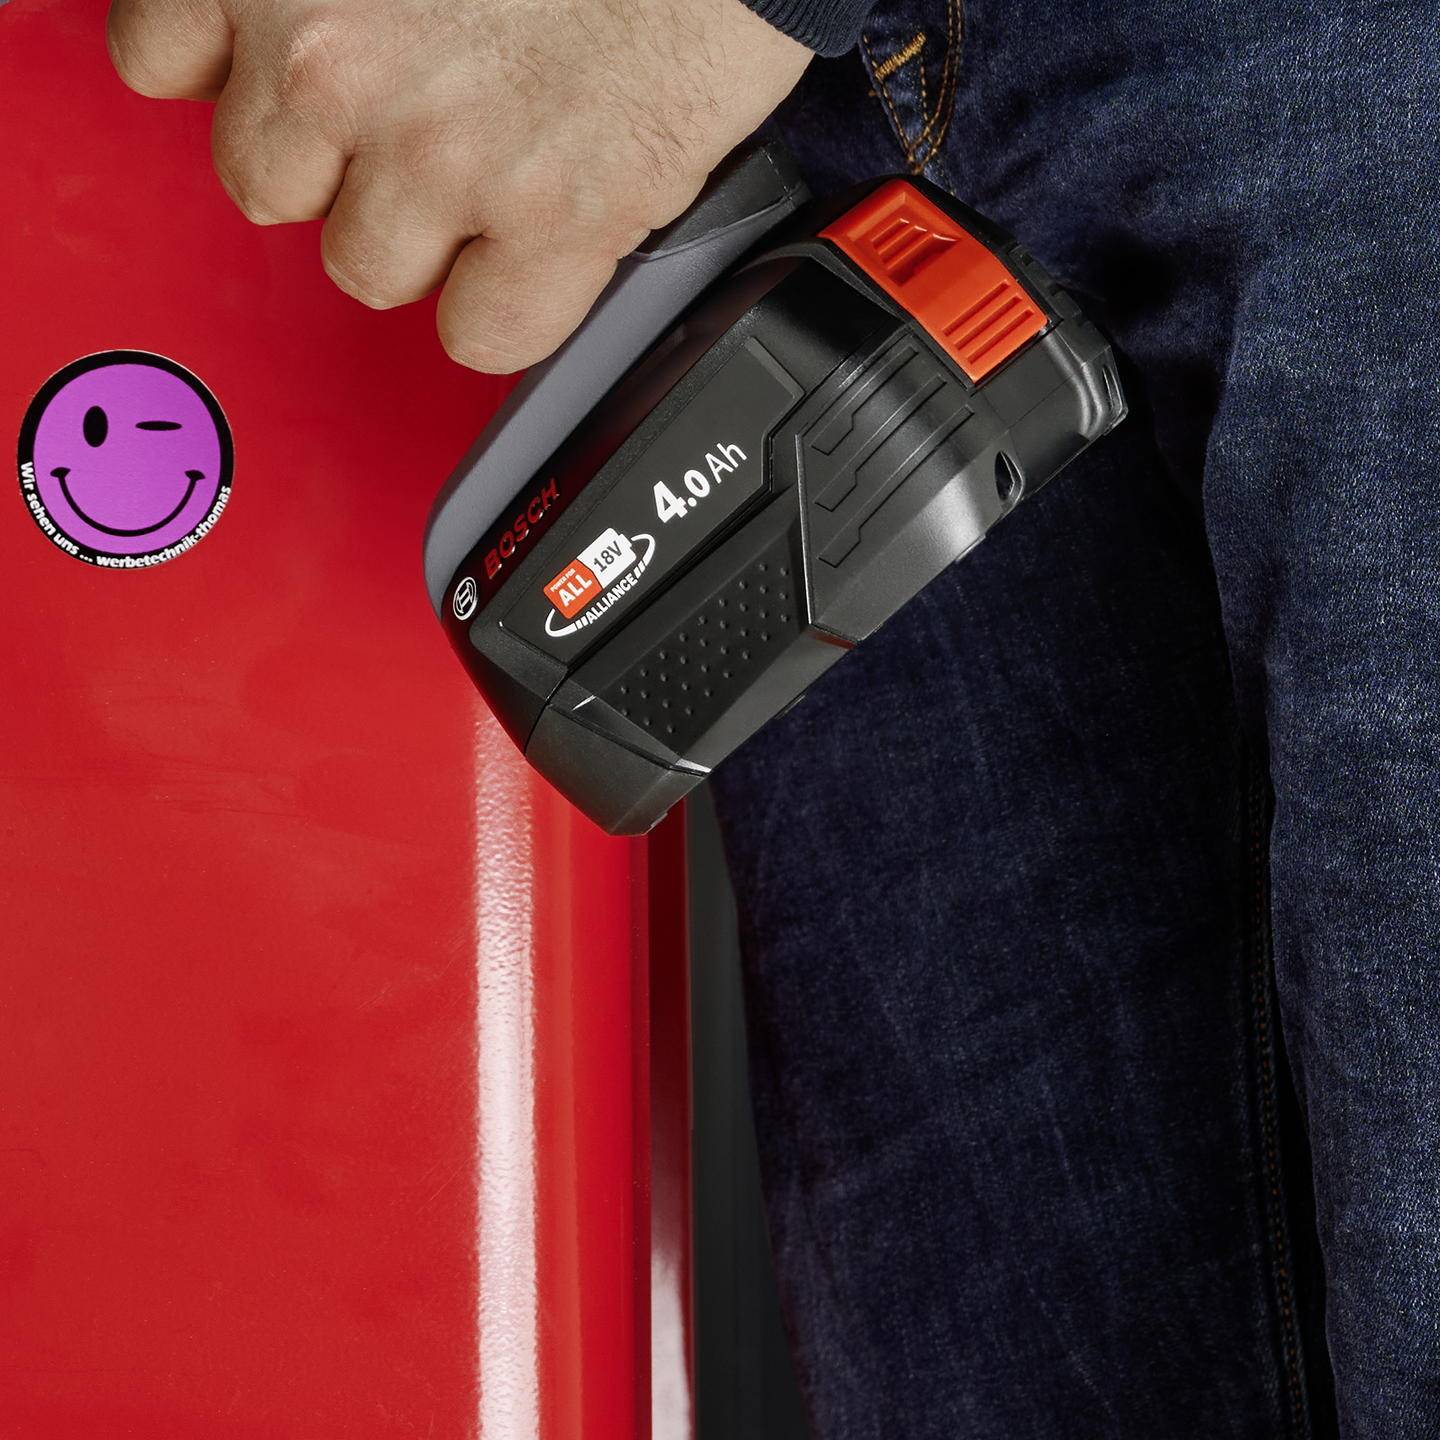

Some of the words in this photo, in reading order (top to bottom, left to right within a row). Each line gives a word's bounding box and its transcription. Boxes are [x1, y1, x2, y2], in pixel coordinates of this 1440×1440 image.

[20, 461, 36, 491] Wir
[653, 469, 711, 524] 4.0
[705, 442, 748, 484] Ah
[26, 492, 56, 536] sehen
[95, 485, 232, 569] werbetechnik-thomas
[483, 478, 560, 579] BOSCH
[53, 534, 80, 556] uns
[593, 540, 624, 573] 18V
[558, 574, 593, 607] ALL
[585, 572, 639, 623] ALLIANCE
